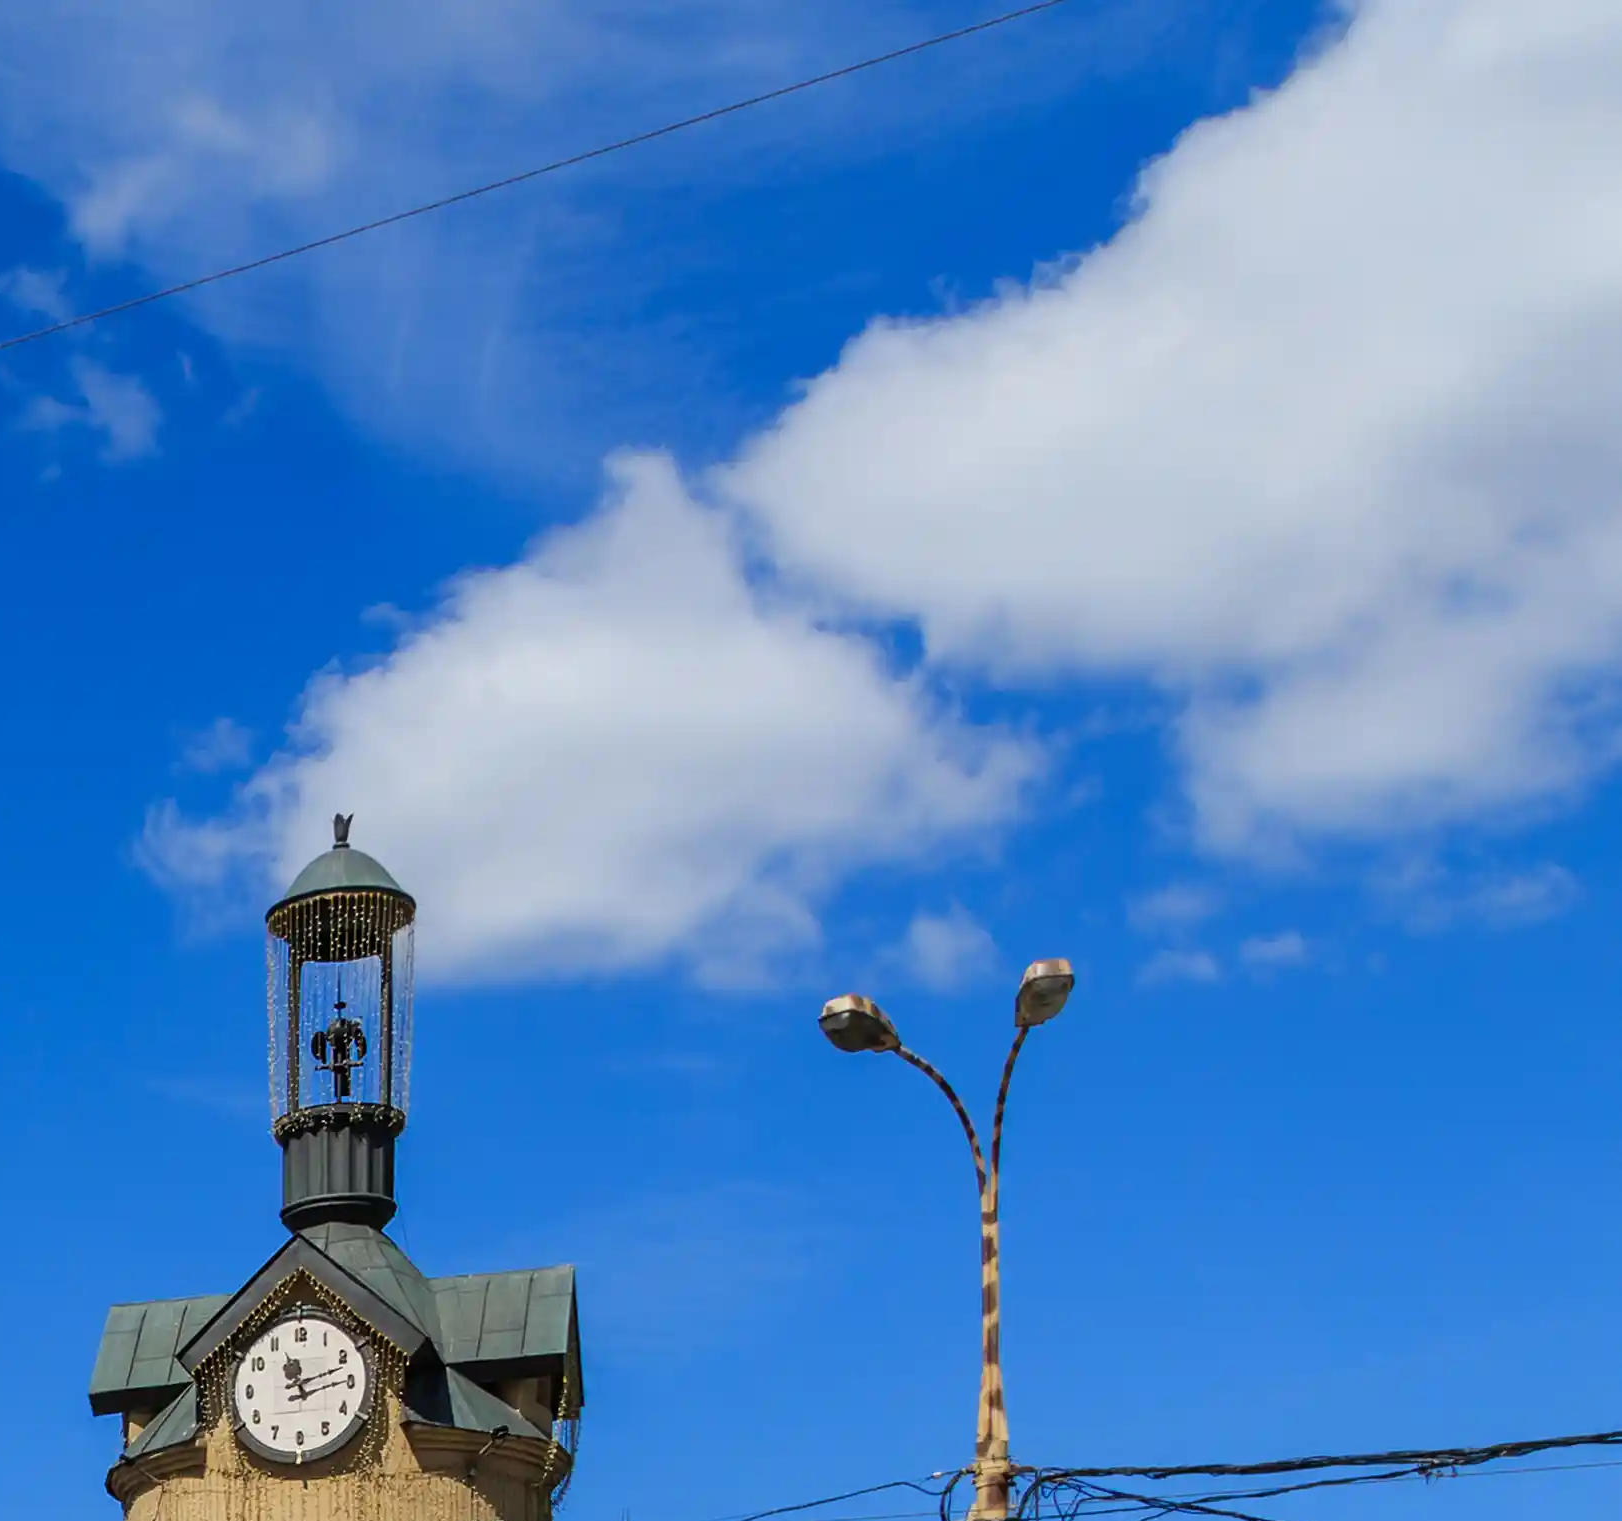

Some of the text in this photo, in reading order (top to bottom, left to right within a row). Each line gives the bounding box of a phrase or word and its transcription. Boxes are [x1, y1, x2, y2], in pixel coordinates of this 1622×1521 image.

[295, 1327, 308, 1343] 12
[323, 1332, 328, 1347] 1
[270, 1336, 279, 1352] 11
[251, 1356, 265, 1373] 10
[271, 1425, 280, 1441] 7
